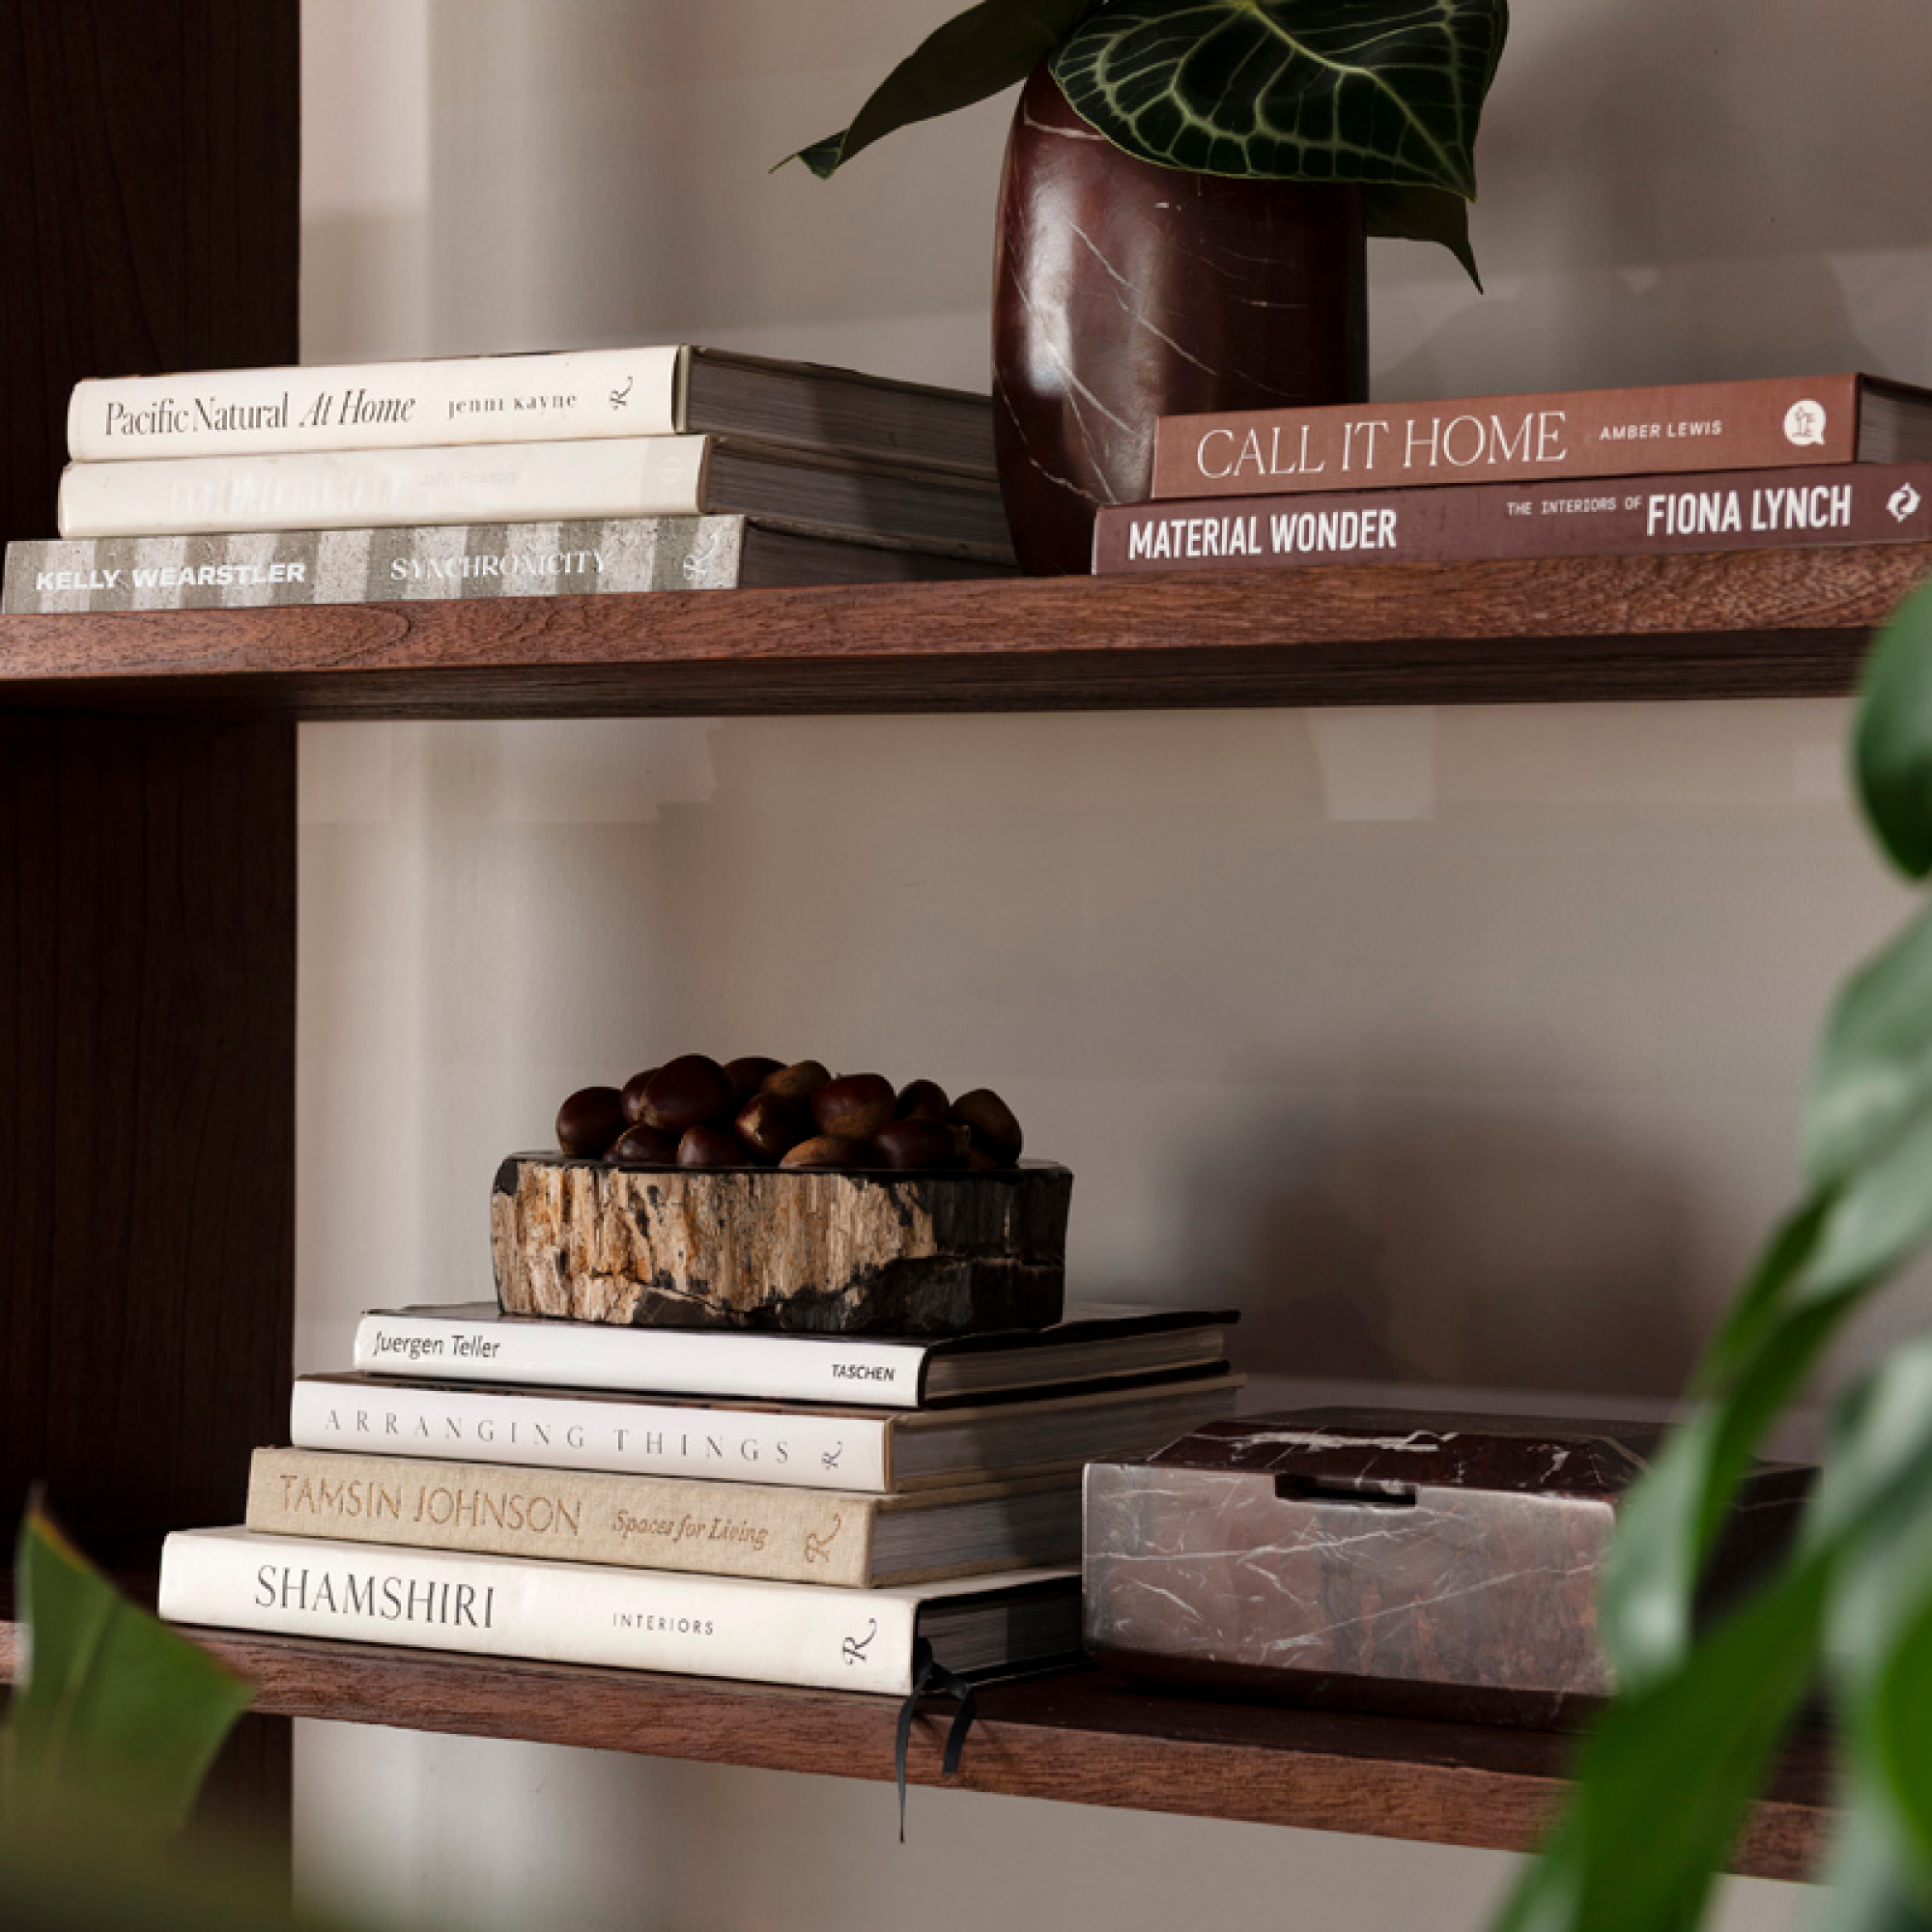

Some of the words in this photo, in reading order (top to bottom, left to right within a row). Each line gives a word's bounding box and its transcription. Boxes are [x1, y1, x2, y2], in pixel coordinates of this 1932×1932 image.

[105, 398, 189, 436] Pacific
[192, 390, 289, 431] Natural
[298, 390, 334, 428] At
[337, 388, 416, 426] Home
[1598, 422, 1662, 440] AMBER
[1665, 419, 1723, 439] LEWIS
[1197, 424, 1326, 479] CALL
[1341, 419, 1390, 472] IT
[1402, 410, 1568, 469] HOME
[1506, 501, 1533, 516] THE
[1540, 497, 1617, 514] INTERIORS
[1624, 494, 1643, 511] OF
[1646, 489, 1743, 537] FIONA
[1749, 484, 1853, 531] LYNCH
[1128, 516, 1263, 561] MATERIAL
[1269, 508, 1398, 554] WONDER
[36, 569, 122, 590] KELLY
[131, 562, 307, 588] WEARSTLER
[390, 548, 606, 580] SYNCHRONICITY
[372, 1330, 445, 1360] Juergen
[450, 1334, 501, 1358] Teller
[830, 1363, 896, 1382] TASCHEN
[326, 1409, 584, 1449] ARRANGING
[613, 1429, 789, 1464] THINGS
[280, 1474, 402, 1520] TAMSIN
[412, 1485, 582, 1536] JOHNSON
[612, 1508, 674, 1539] Spaces
[672, 1513, 706, 1544] for
[707, 1517, 769, 1551] Living
[254, 1564, 495, 1629] SHAMSHIRI
[612, 1612, 714, 1635] INTERIORS
